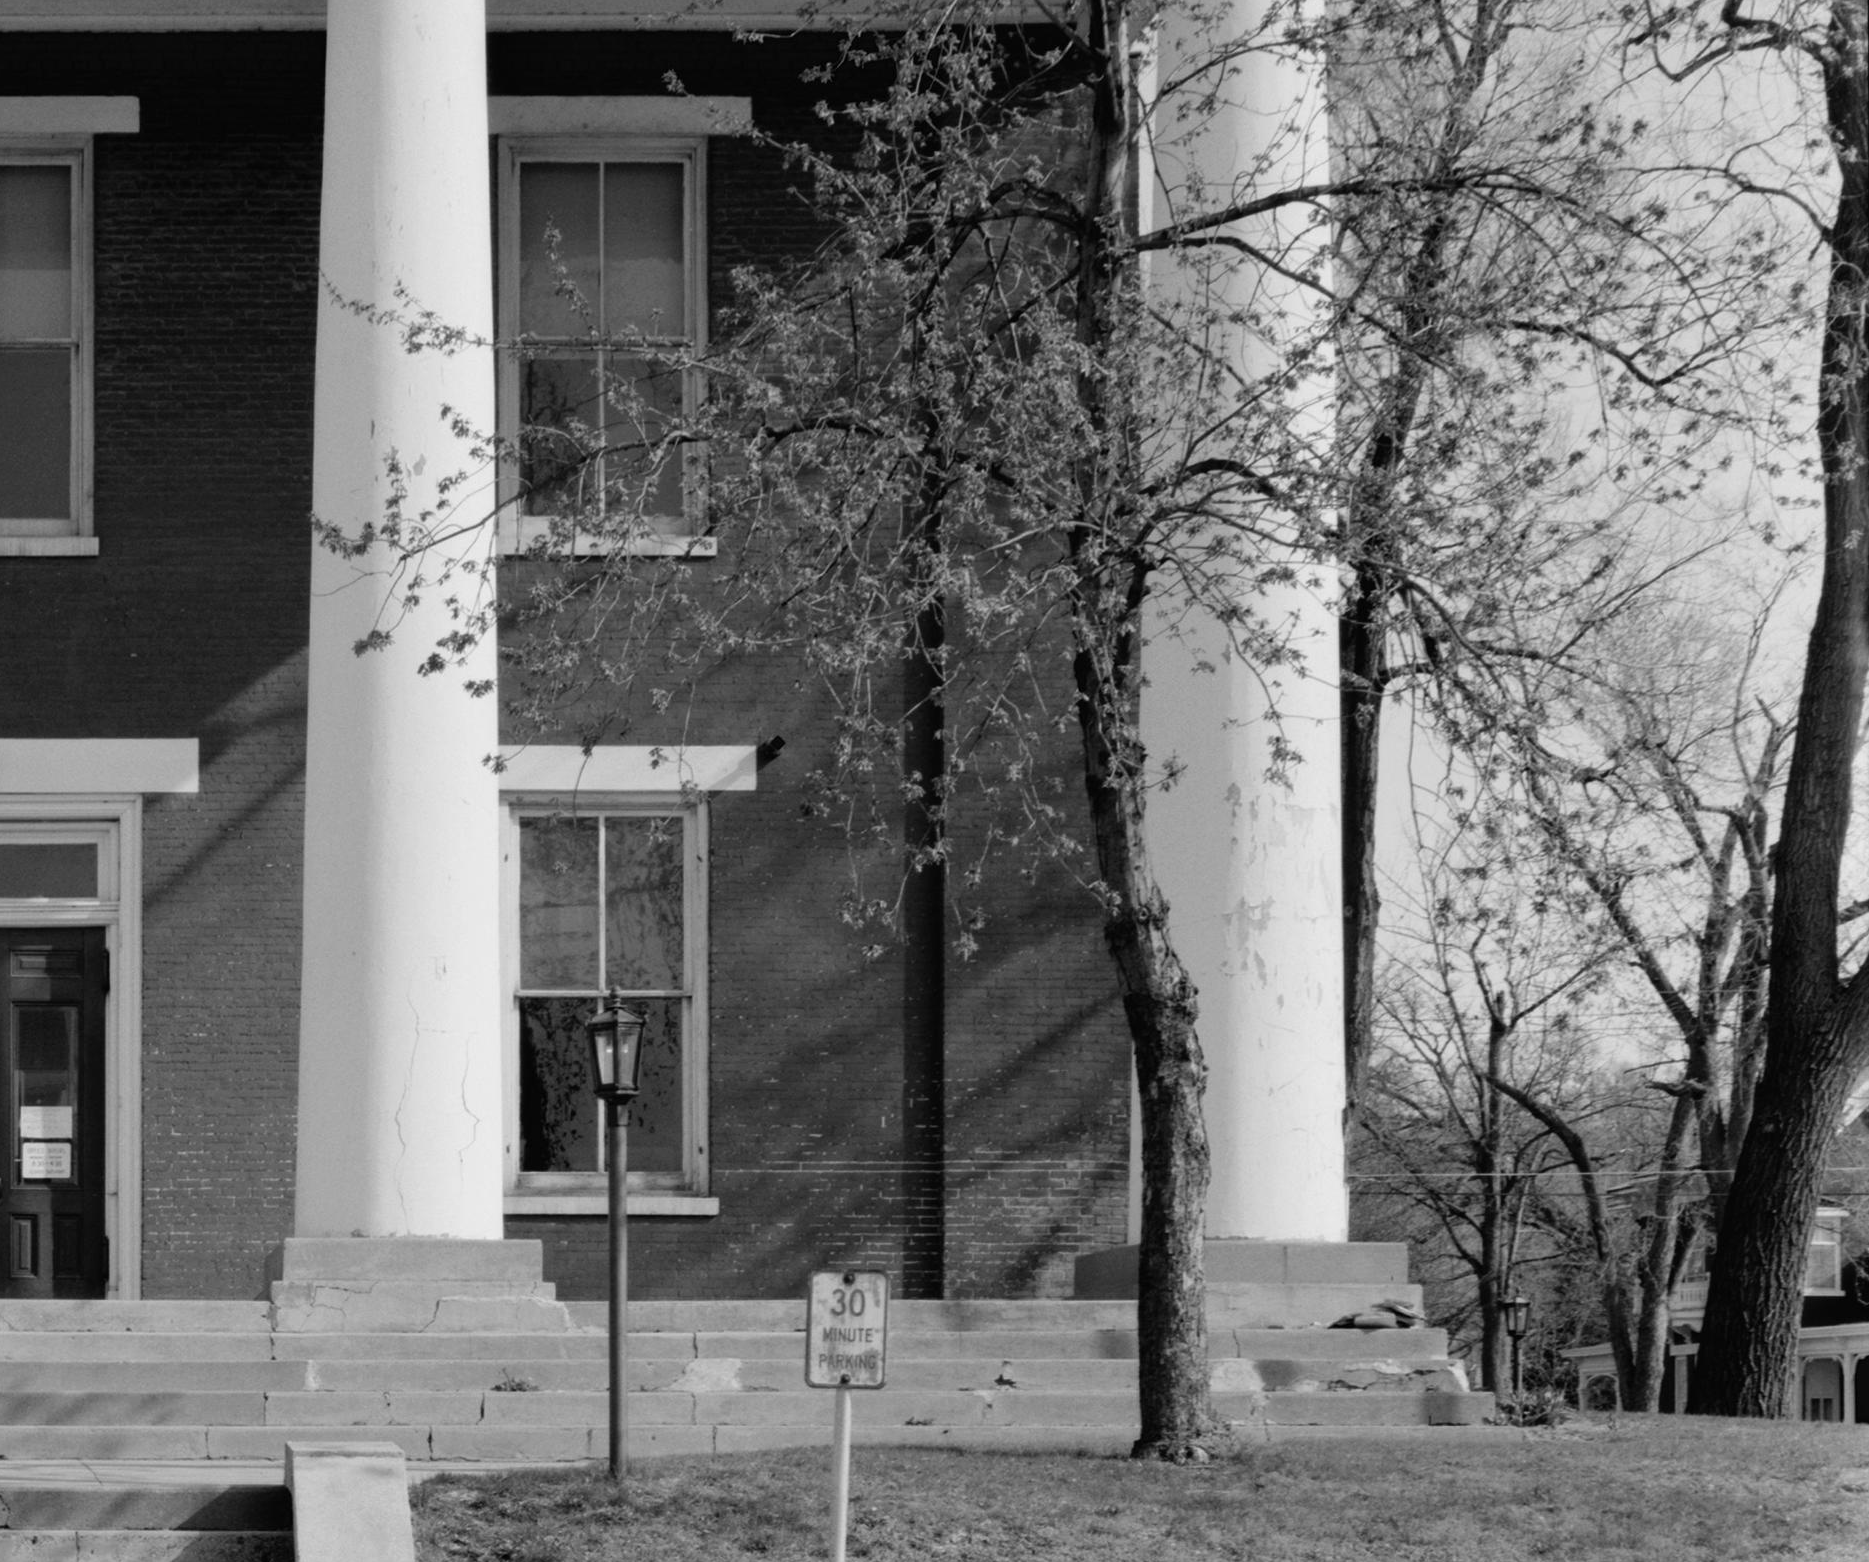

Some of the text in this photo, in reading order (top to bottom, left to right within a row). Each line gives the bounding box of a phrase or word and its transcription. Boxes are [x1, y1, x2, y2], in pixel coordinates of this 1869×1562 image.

[830, 1288, 866, 1317] 30
[823, 1327, 874, 1343] MINUTE
[819, 1354, 877, 1370] PARKING
